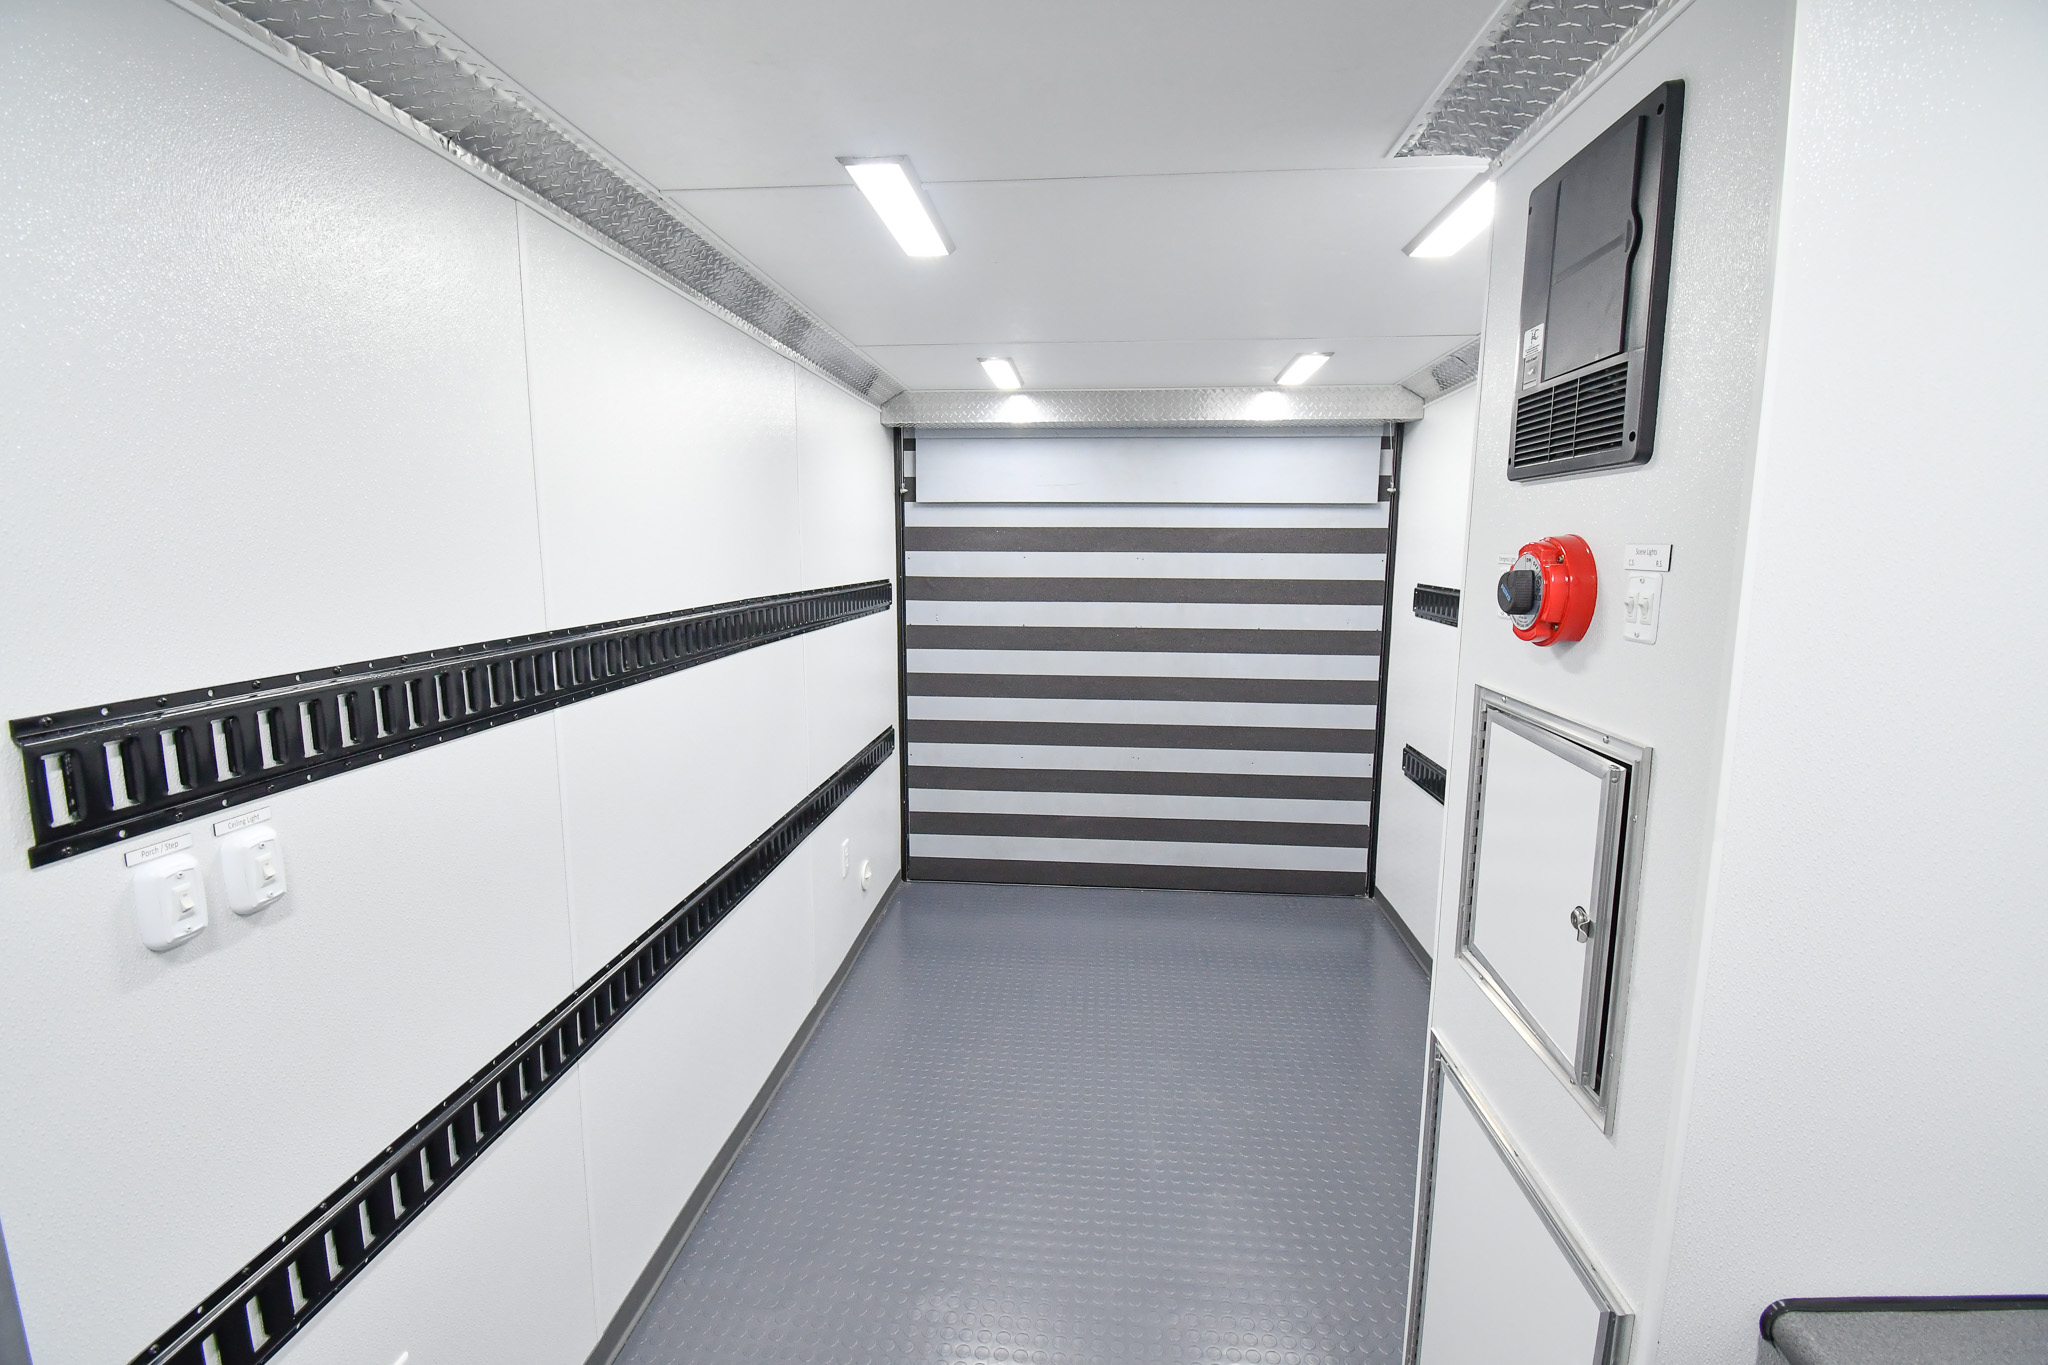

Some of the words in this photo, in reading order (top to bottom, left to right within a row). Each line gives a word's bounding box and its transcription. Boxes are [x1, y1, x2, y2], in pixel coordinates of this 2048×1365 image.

[1635, 548, 1646, 556] Scene
[1646, 549, 1658, 557] Lights
[227, 817, 246, 830] Ceiling
[246, 813, 260, 826] Light
[141, 846, 159, 859] Porch
[164, 841, 179, 852] Step
